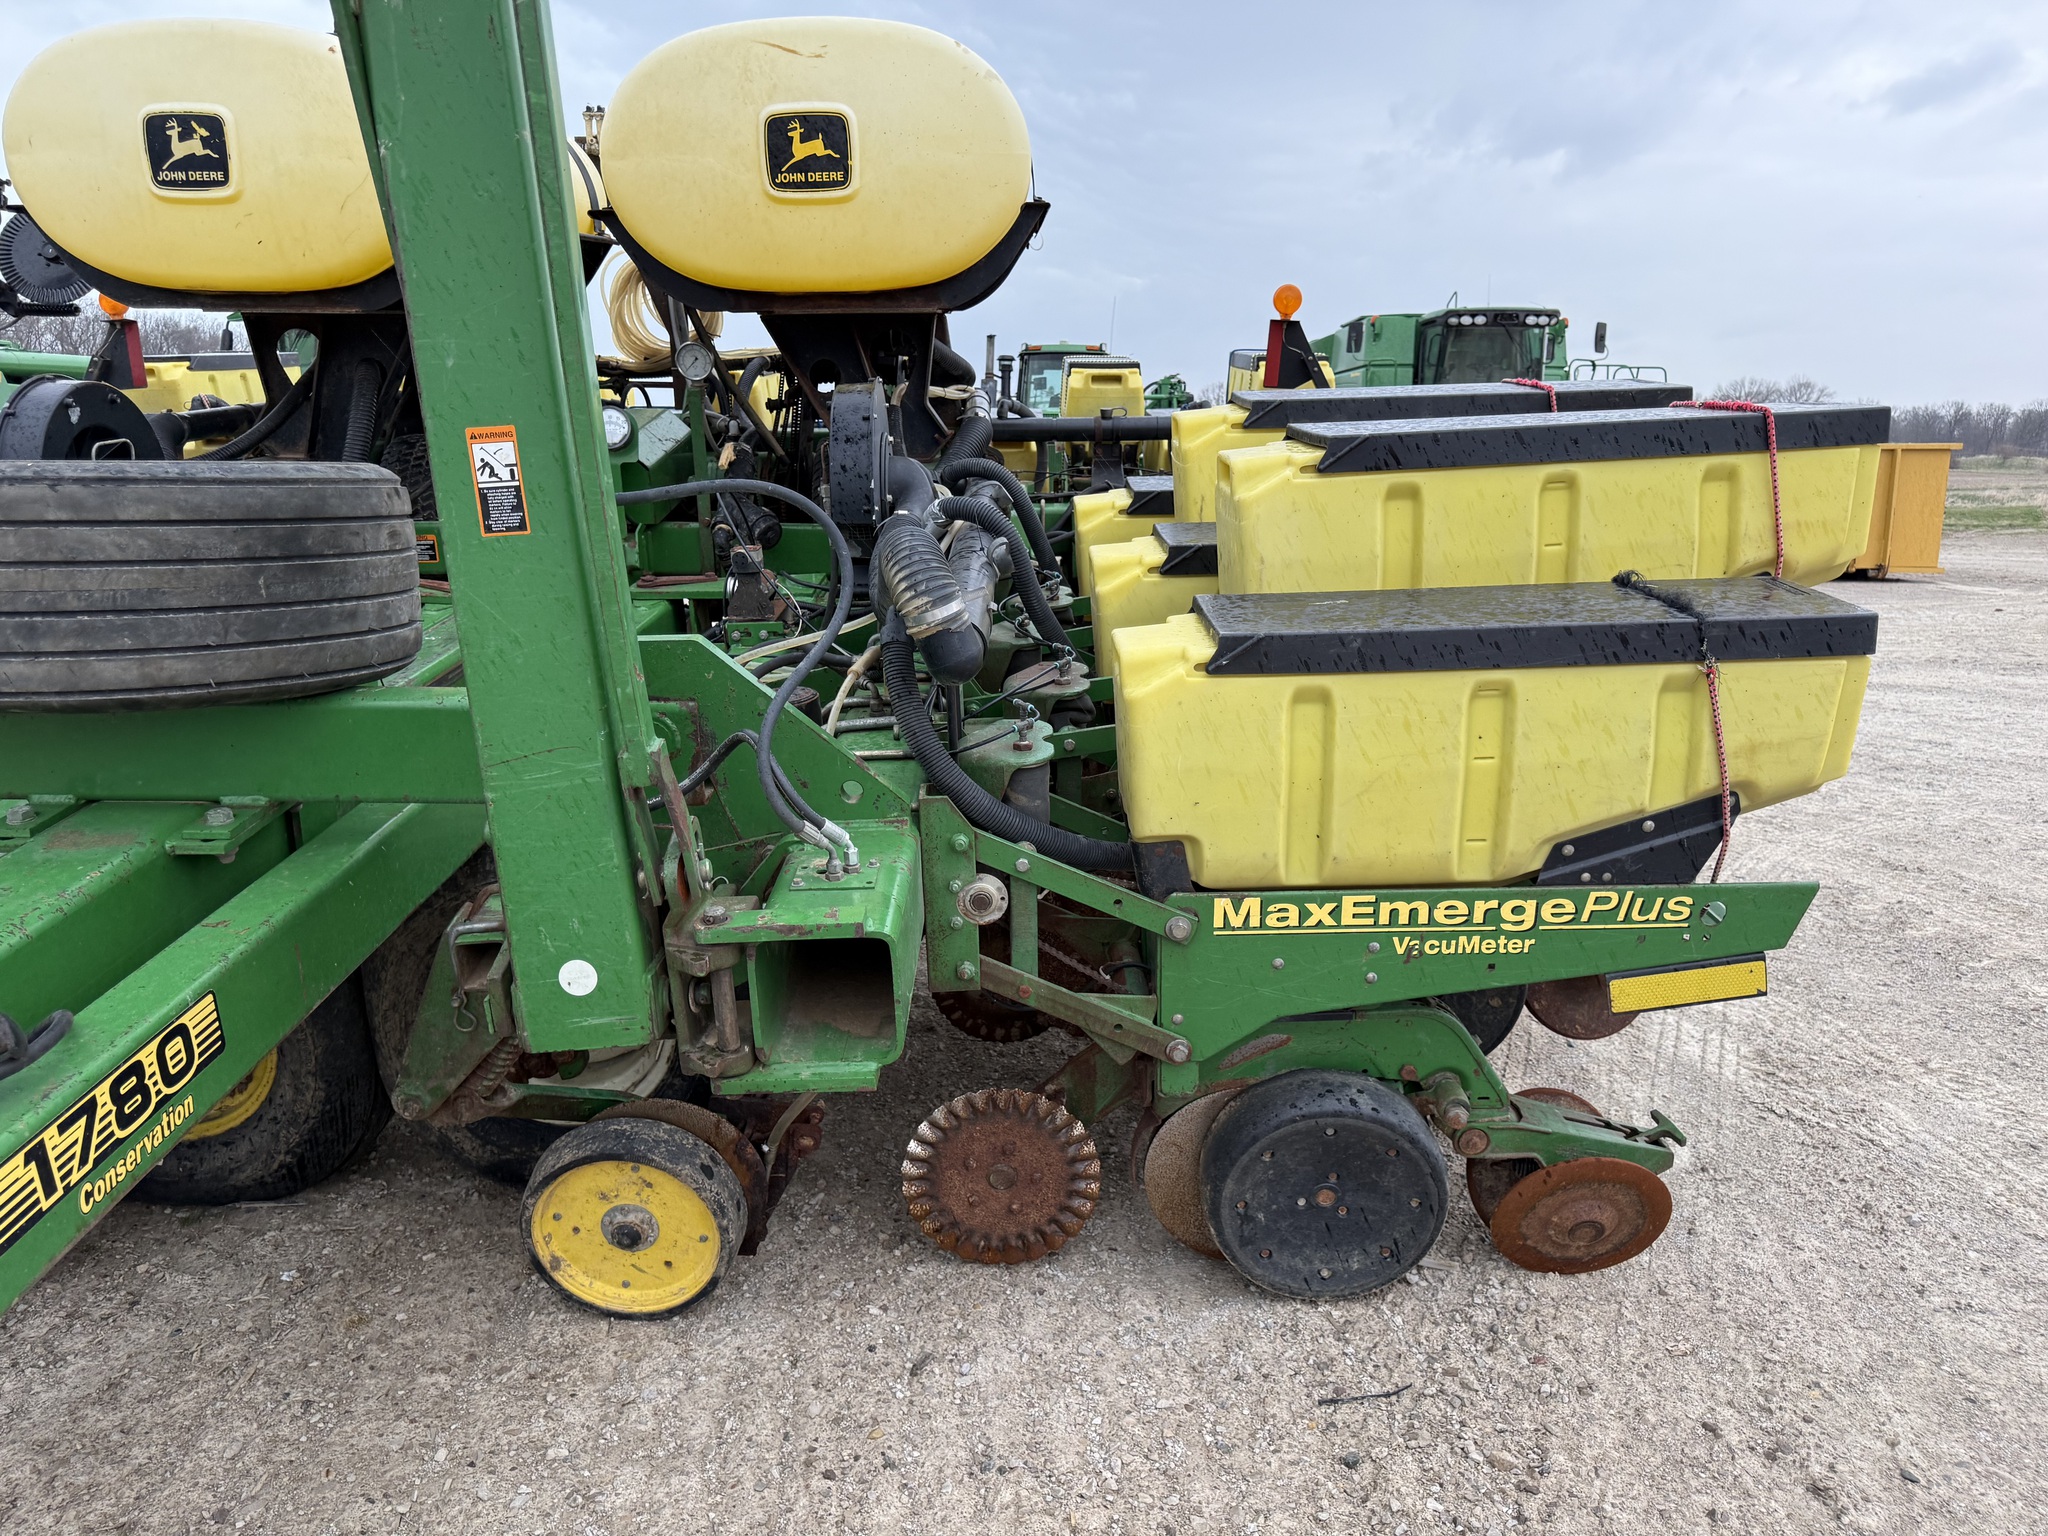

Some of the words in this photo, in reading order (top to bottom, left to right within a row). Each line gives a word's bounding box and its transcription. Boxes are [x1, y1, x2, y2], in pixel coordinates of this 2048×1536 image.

[157, 171, 186, 181] JOHN
[188, 171, 225, 181] DEERE
[775, 172, 805, 183] JOHN
[807, 171, 845, 182] DEERE
[477, 431, 514, 439] WARNING
[23, 1022, 196, 1209] 1780
[78, 1093, 195, 1215] Conservation
